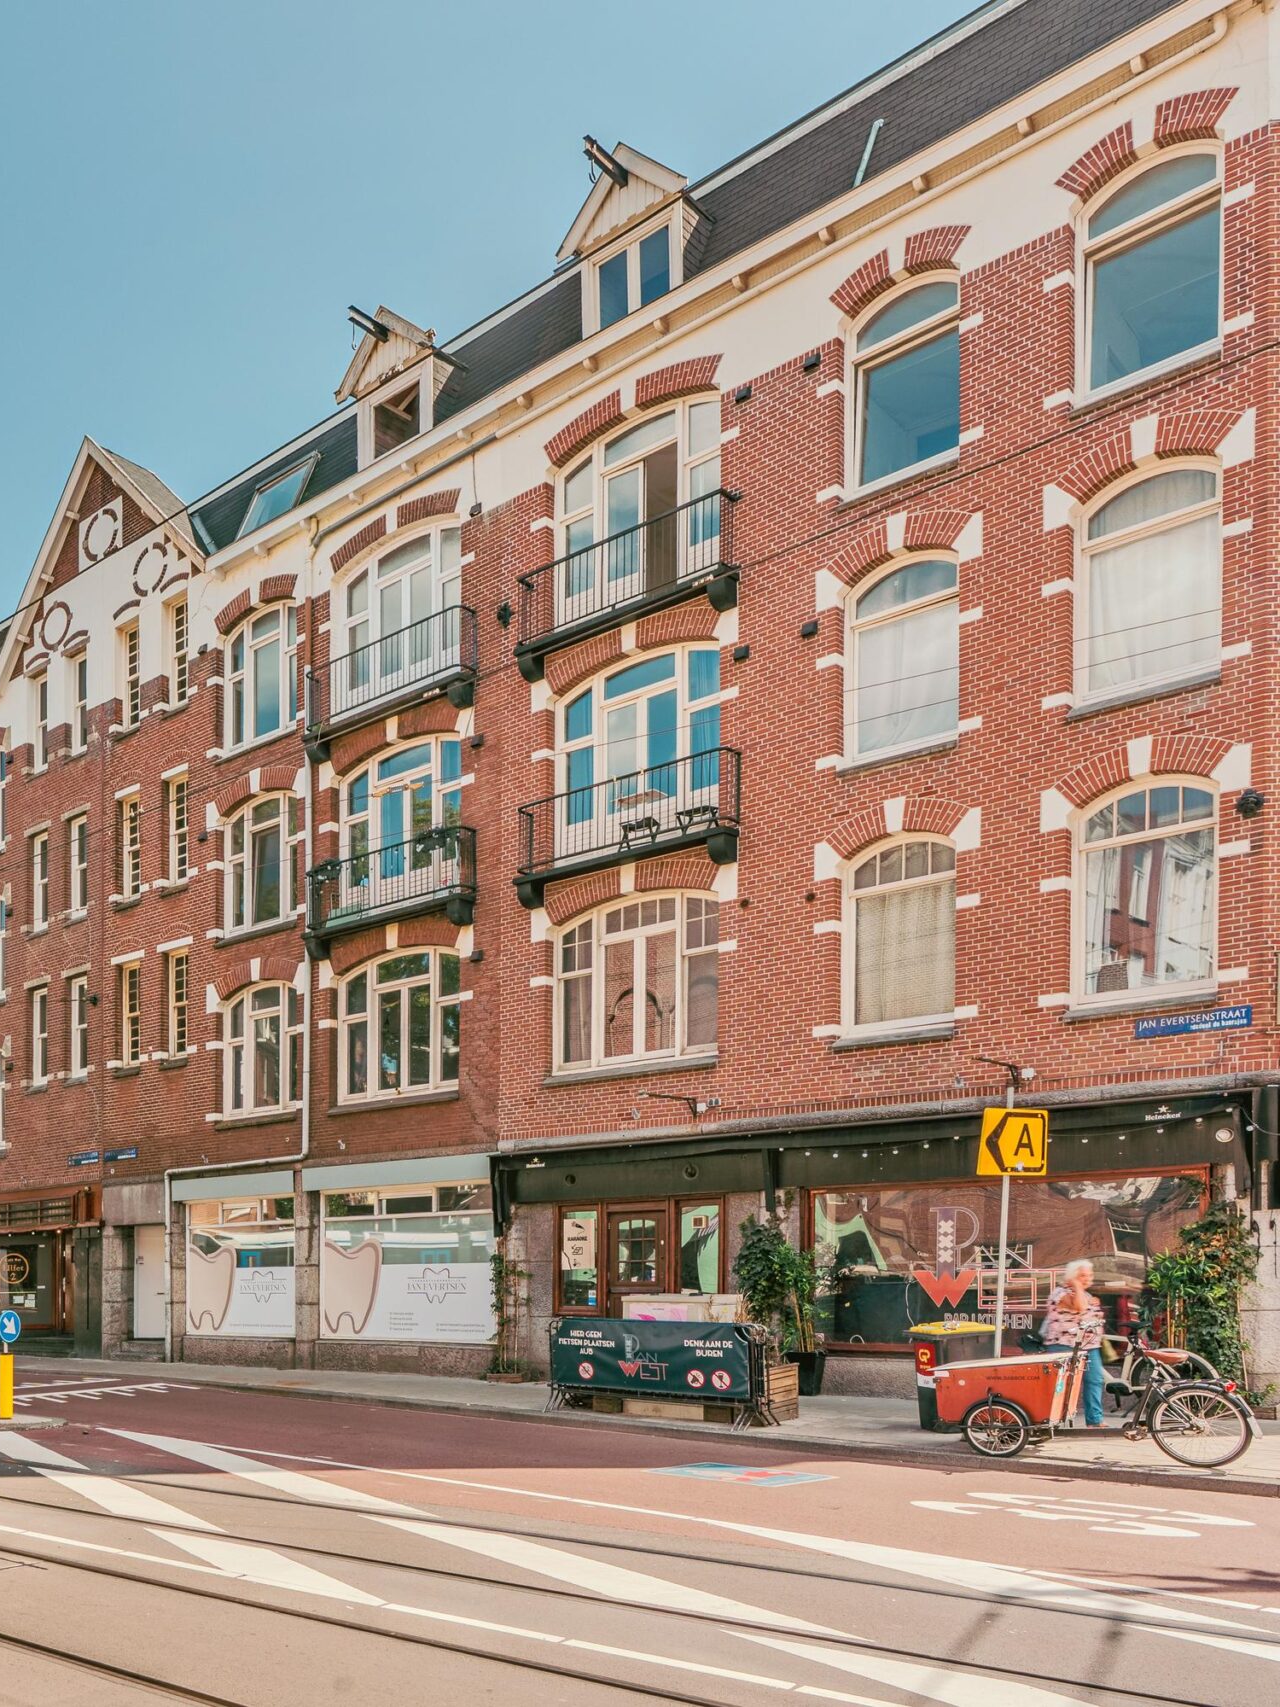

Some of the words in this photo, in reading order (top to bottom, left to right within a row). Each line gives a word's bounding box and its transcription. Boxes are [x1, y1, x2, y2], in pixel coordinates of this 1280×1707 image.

[1139, 1020, 1157, 1031] JAN
[1160, 1008, 1248, 1027] EVERTSENSTRAAT
[1145, 1111, 1181, 1121] Heineken
[1013, 1123, 1035, 1157] A
[929, 1206, 1032, 1281] PAN
[9, 1272, 17, 1281] 2
[911, 1269, 1066, 1309] WEST
[570, 1329, 585, 1337] HIER
[585, 1331, 602, 1339] GEEN
[558, 1337, 583, 1346] FIETSEN
[583, 1339, 616, 1348] PLAATSEN
[623, 1333, 658, 1363] PAN
[683, 1339, 704, 1348] DENK
[704, 1340, 722, 1348] AAN
[722, 1340, 733, 1349] DE
[695, 1349, 724, 1358] BUREN
[618, 1359, 669, 1381] WEST
